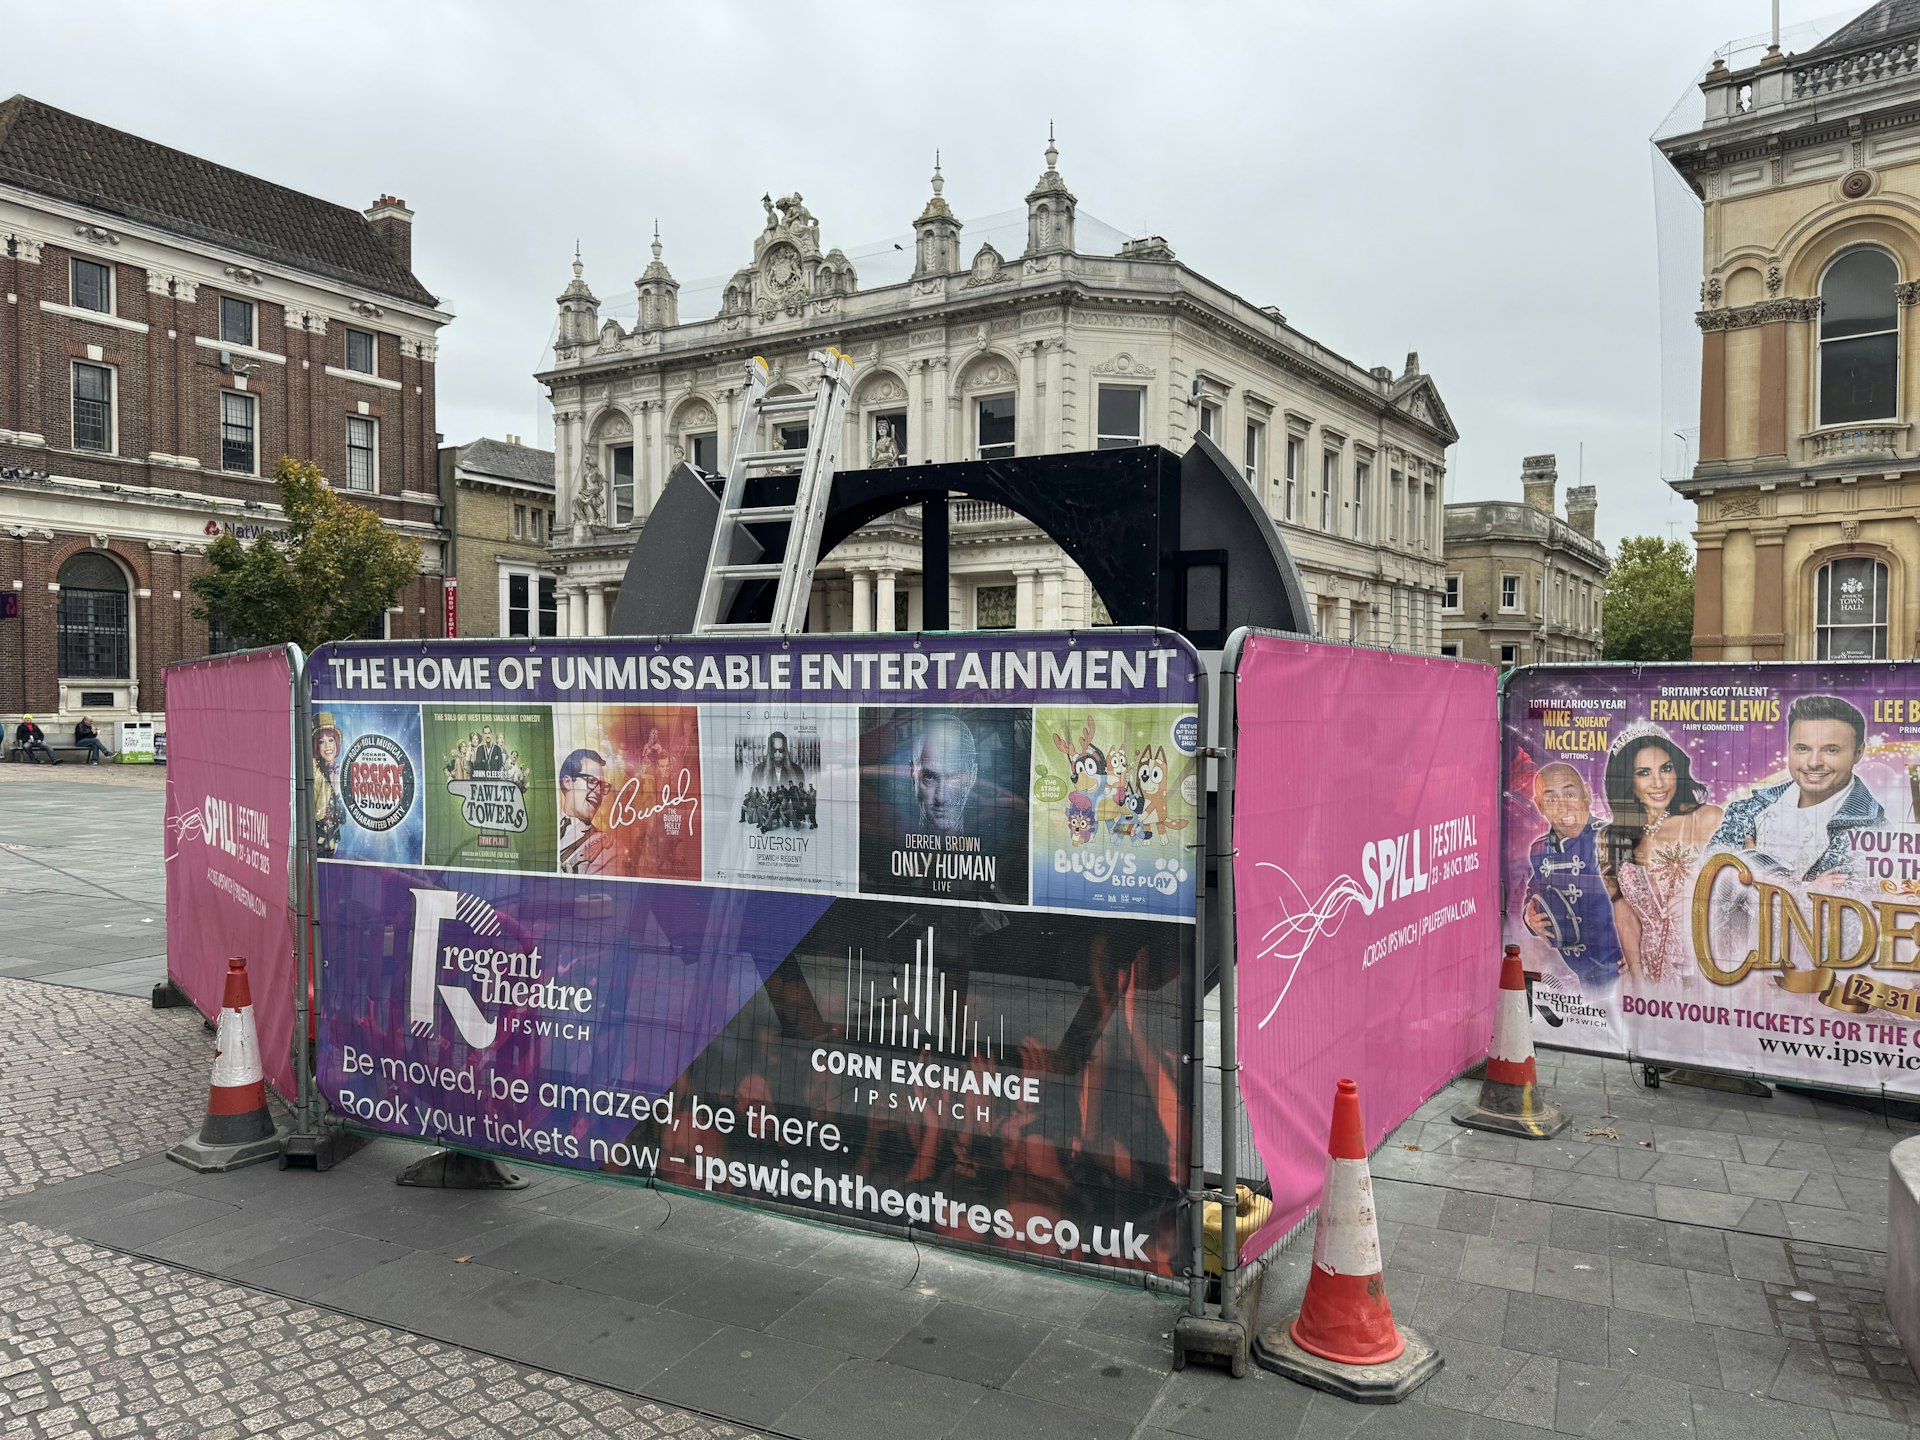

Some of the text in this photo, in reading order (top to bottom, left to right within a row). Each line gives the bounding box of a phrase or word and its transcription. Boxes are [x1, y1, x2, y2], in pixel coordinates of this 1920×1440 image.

[329, 648, 1177, 690] THE HOME OF UNMISSABLE ENTERTAINMENT
[1661, 686, 1769, 697] BRITAIN'S GOT TALENT
[1529, 699, 1626, 710] 10TH HILARIOUS YEAR!
[1650, 699, 1781, 722] FRANCINE LEWIS
[1873, 699, 1904, 723] LEE
[434, 713, 444, 721] THE
[444, 713, 457, 722] SOLD
[467, 713, 481, 722] WEST
[482, 714, 492, 722] END
[493, 714, 510, 722] SMASH
[520, 714, 540, 722] COMEDY
[1543, 710, 1571, 728] MIKE
[1683, 723, 1744, 732] FAIRY GODMOTHER
[376, 738, 403, 761] MUSICAL
[1545, 730, 1608, 752] McCLEAN
[1561, 752, 1589, 760] BUTTONS
[350, 761, 405, 784] ROCKY
[472, 770, 486, 778] JOHN
[351, 782, 404, 804] HORROR
[470, 784, 516, 802] FAWLTY
[609, 767, 698, 836] Buddy
[348, 803, 406, 829] A GUARANTEED PARTY
[360, 800, 393, 810] Show
[467, 802, 524, 828] TOWERS
[203, 795, 269, 857] SPILL FESTIVAL
[663, 814, 681, 822] BUDDY
[664, 822, 681, 830] HOLLY
[482, 836, 492, 846] THE
[749, 835, 810, 852] DIVERSITY
[905, 833, 980, 852] DERREN BROWN
[756, 854, 802, 863] IPSWICH REGENT
[891, 850, 996, 882] ONLY HUMAN
[1054, 849, 1137, 883] BLUEY'S
[1361, 815, 1478, 916] SPILL FESTIVAL
[1450, 857, 1462, 878] OCT
[1464, 852, 1479, 873] 2025
[1866, 857, 1894, 878] TO
[933, 881, 952, 893] LIVE
[1112, 875, 1172, 889] BIG PLAY
[1692, 852, 1920, 986] CINDE
[1362, 936, 1387, 971] ACROSS
[1387, 923, 1418, 954] IPSWICH
[1421, 897, 1476, 936] SPILLFESTIVAL.COM
[442, 946, 542, 983] regent
[481, 976, 593, 1013] theatre
[1536, 991, 1583, 1006] regent
[1853, 979, 1874, 1000] 12
[1886, 991, 1909, 1010] 31
[1555, 1001, 1607, 1018] theatre
[1622, 995, 1672, 1019] BOOK
[1676, 1002, 1731, 1027] YOUR
[1733, 1009, 1815, 1036] TICKETS
[1820, 1019, 1862, 1042] FOR
[1866, 1024, 1908, 1047] THE
[503, 1017, 590, 1041] IPSWICH
[1566, 1017, 1607, 1028] IPSWICH
[1759, 1036, 1920, 1071] www.ipswic
[811, 1048, 1040, 1103] CORN EXCHANGE
[342, 1045, 850, 1154] Be moved, be amazed, be there.
[853, 1087, 990, 1122] IPSWICH
[339, 1089, 409, 1126] Book
[415, 1104, 476, 1136] your
[483, 1112, 579, 1160] tickets
[590, 1139, 660, 1171] now
[695, 1145, 1152, 1264] ipswichtheatres.co.uk
